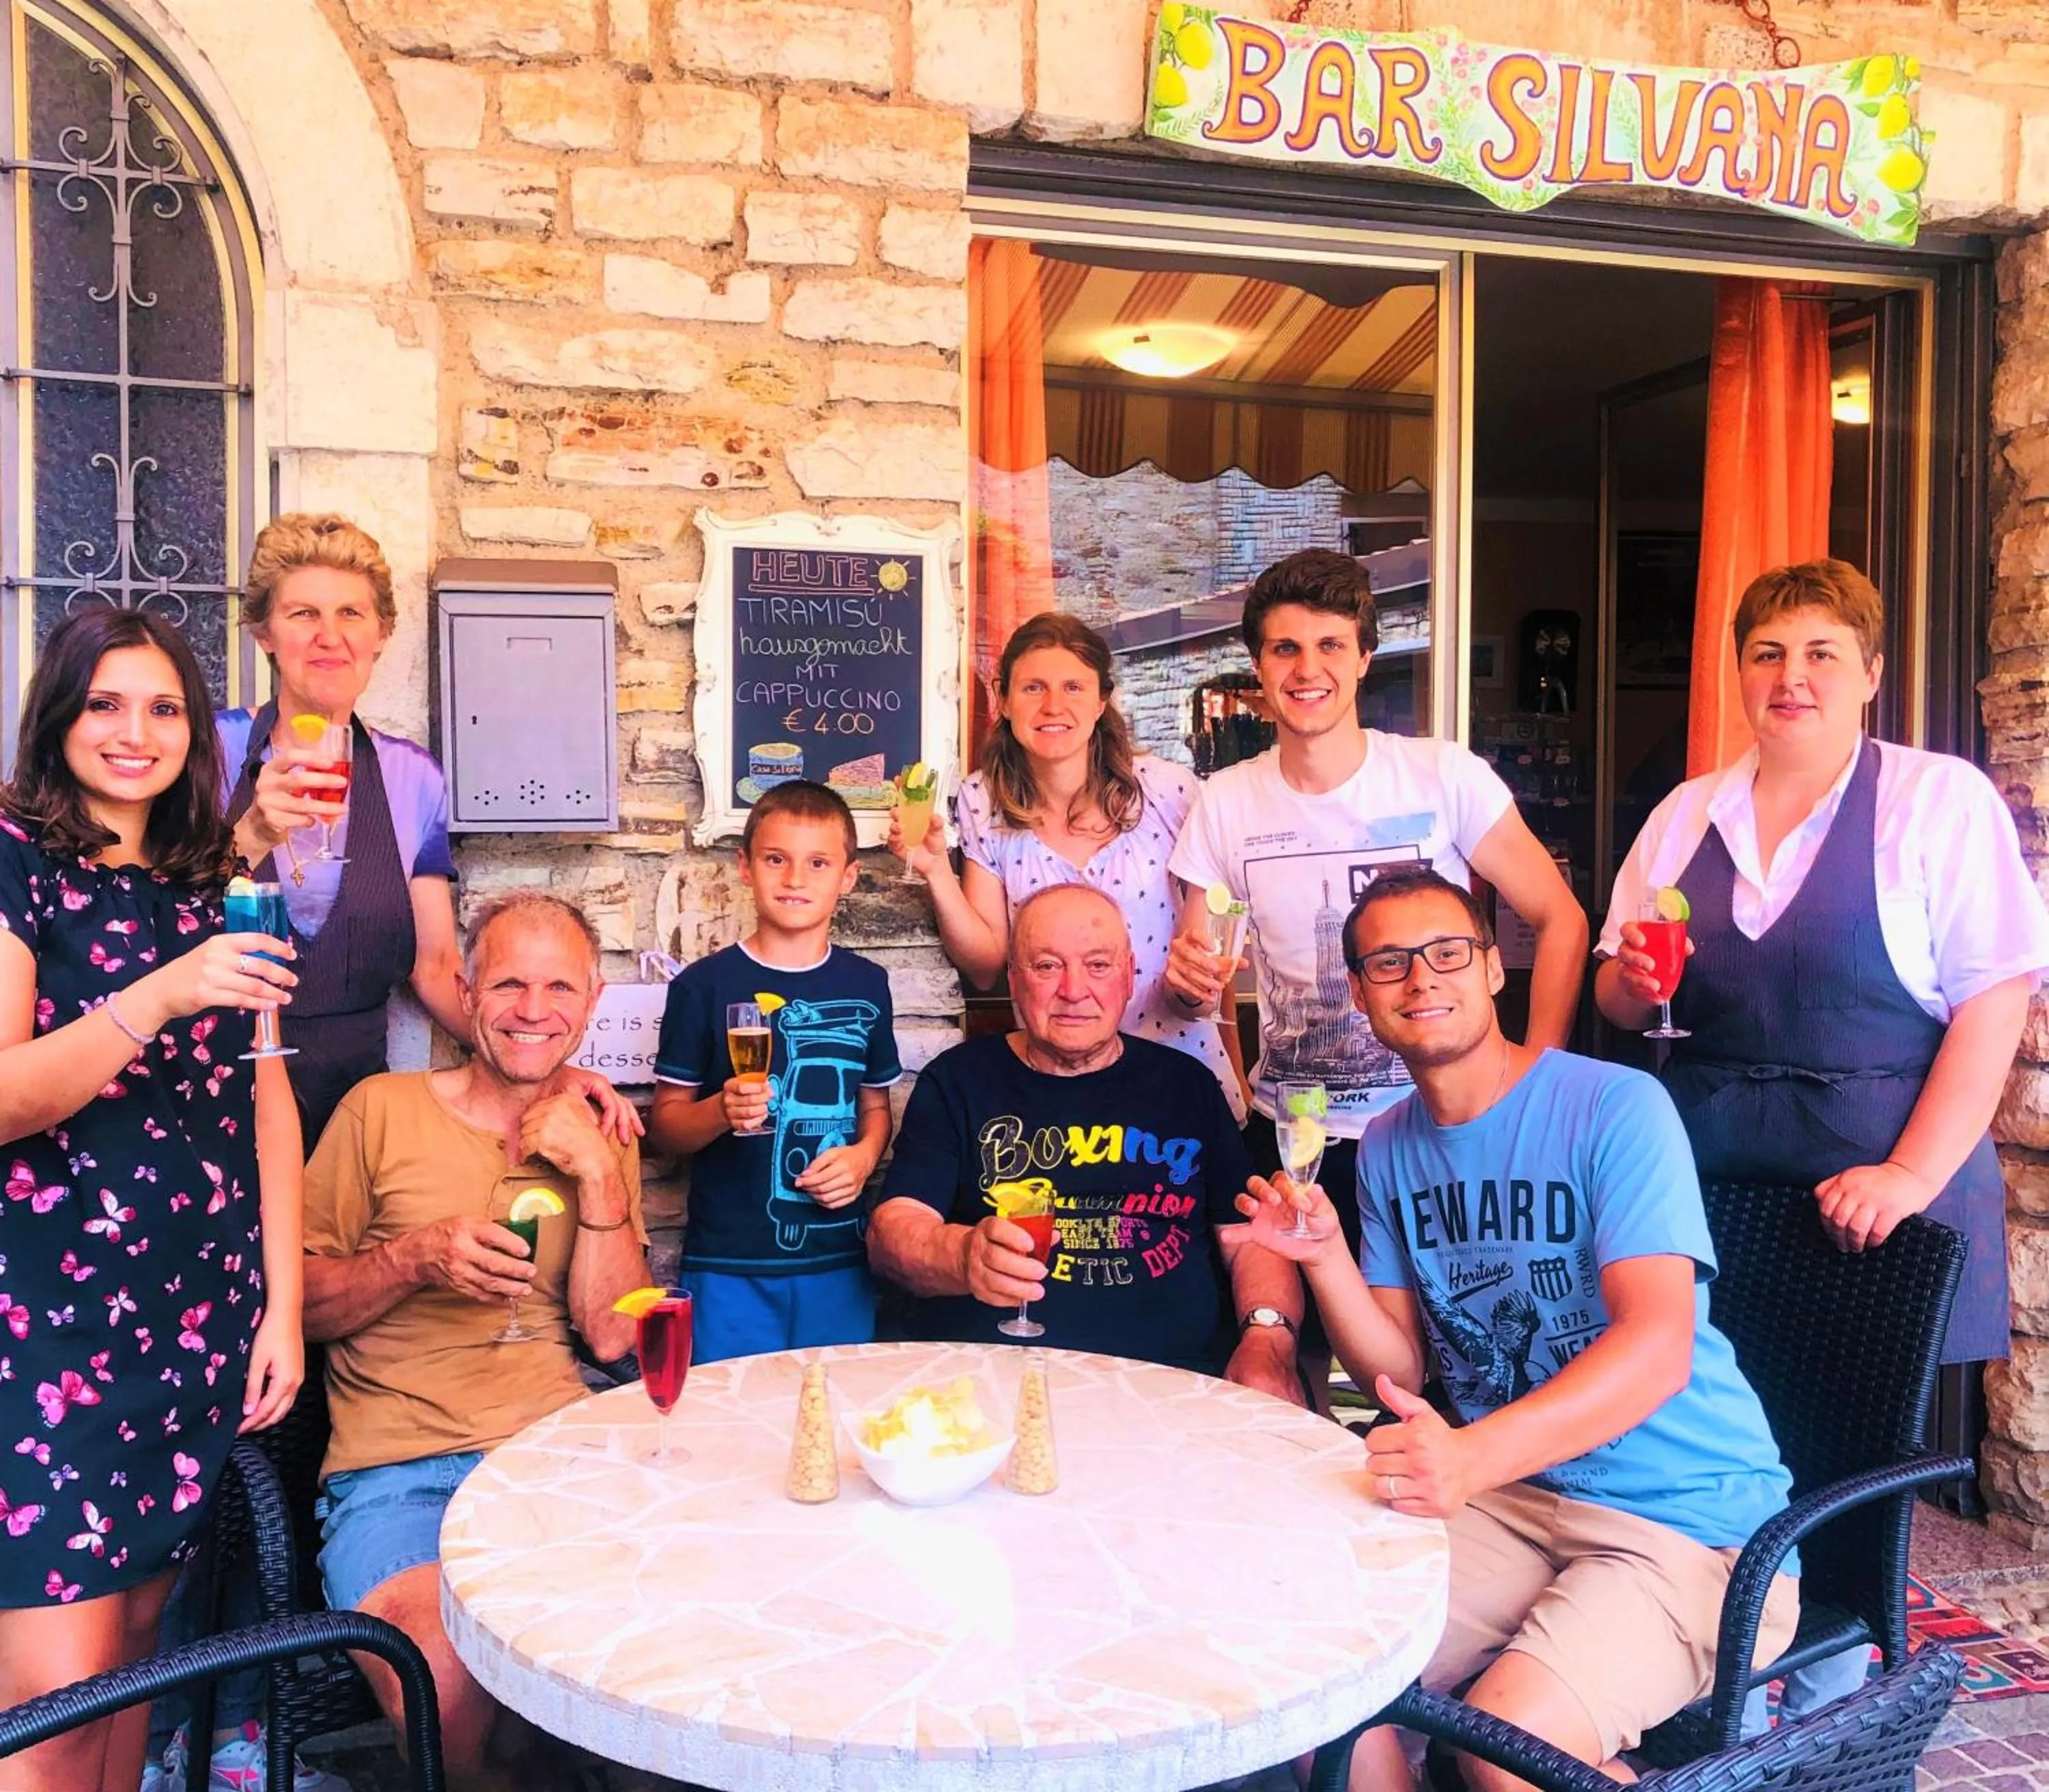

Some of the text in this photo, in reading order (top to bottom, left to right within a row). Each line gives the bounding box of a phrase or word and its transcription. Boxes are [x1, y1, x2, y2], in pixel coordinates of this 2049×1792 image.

[1201, 17, 1858, 218] BAR SILVANA
[753, 551, 868, 587] HEUTE
[796, 664, 839, 682] MIT
[736, 682, 902, 711] CAPPUCCINO
[622, 1009, 642, 1031] is
[579, 1040, 657, 1067] desse
[1329, 1092, 1370, 1104] ORK
[978, 1115, 1202, 1191] Boxing
[1063, 1238, 1100, 1249] SINCE
[1449, 1259, 1514, 1291] Heritage
[1552, 1310, 1589, 1332] 1975
